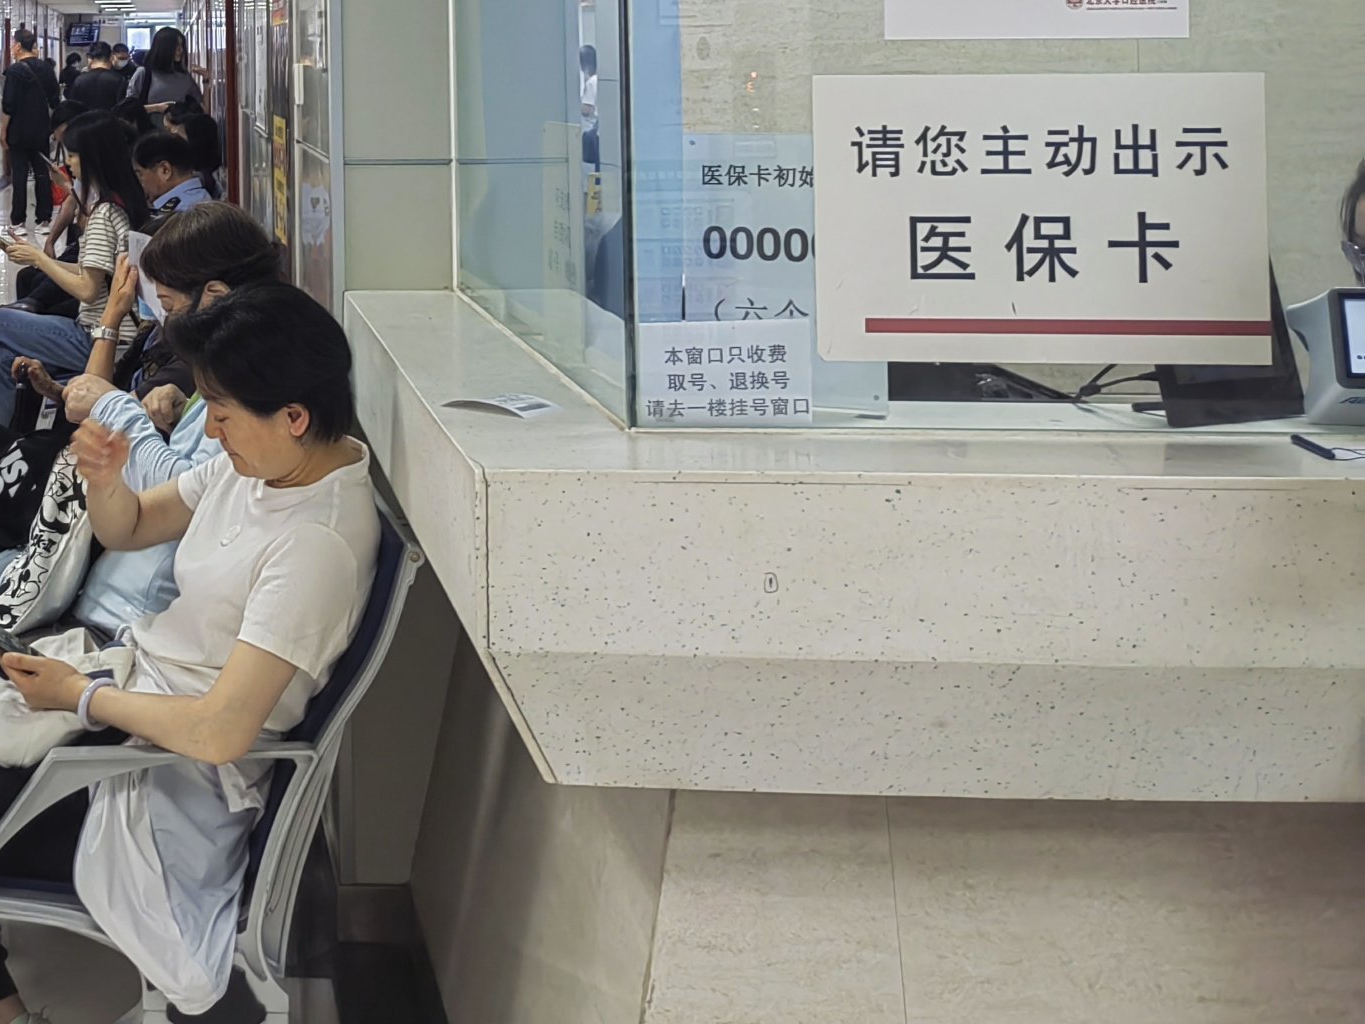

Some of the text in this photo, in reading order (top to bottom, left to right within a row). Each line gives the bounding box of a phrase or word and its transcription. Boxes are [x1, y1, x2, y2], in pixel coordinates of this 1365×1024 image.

[850, 123, 1230, 179] 请您主动出示
[702, 225, 815, 262] 0000
[909, 211, 1181, 284] 医保卡
[664, 344, 787, 366] 本窗口只收费
[667, 370, 790, 392] 取号、退换号
[645, 397, 810, 418] 请去一楼挂号窗口
